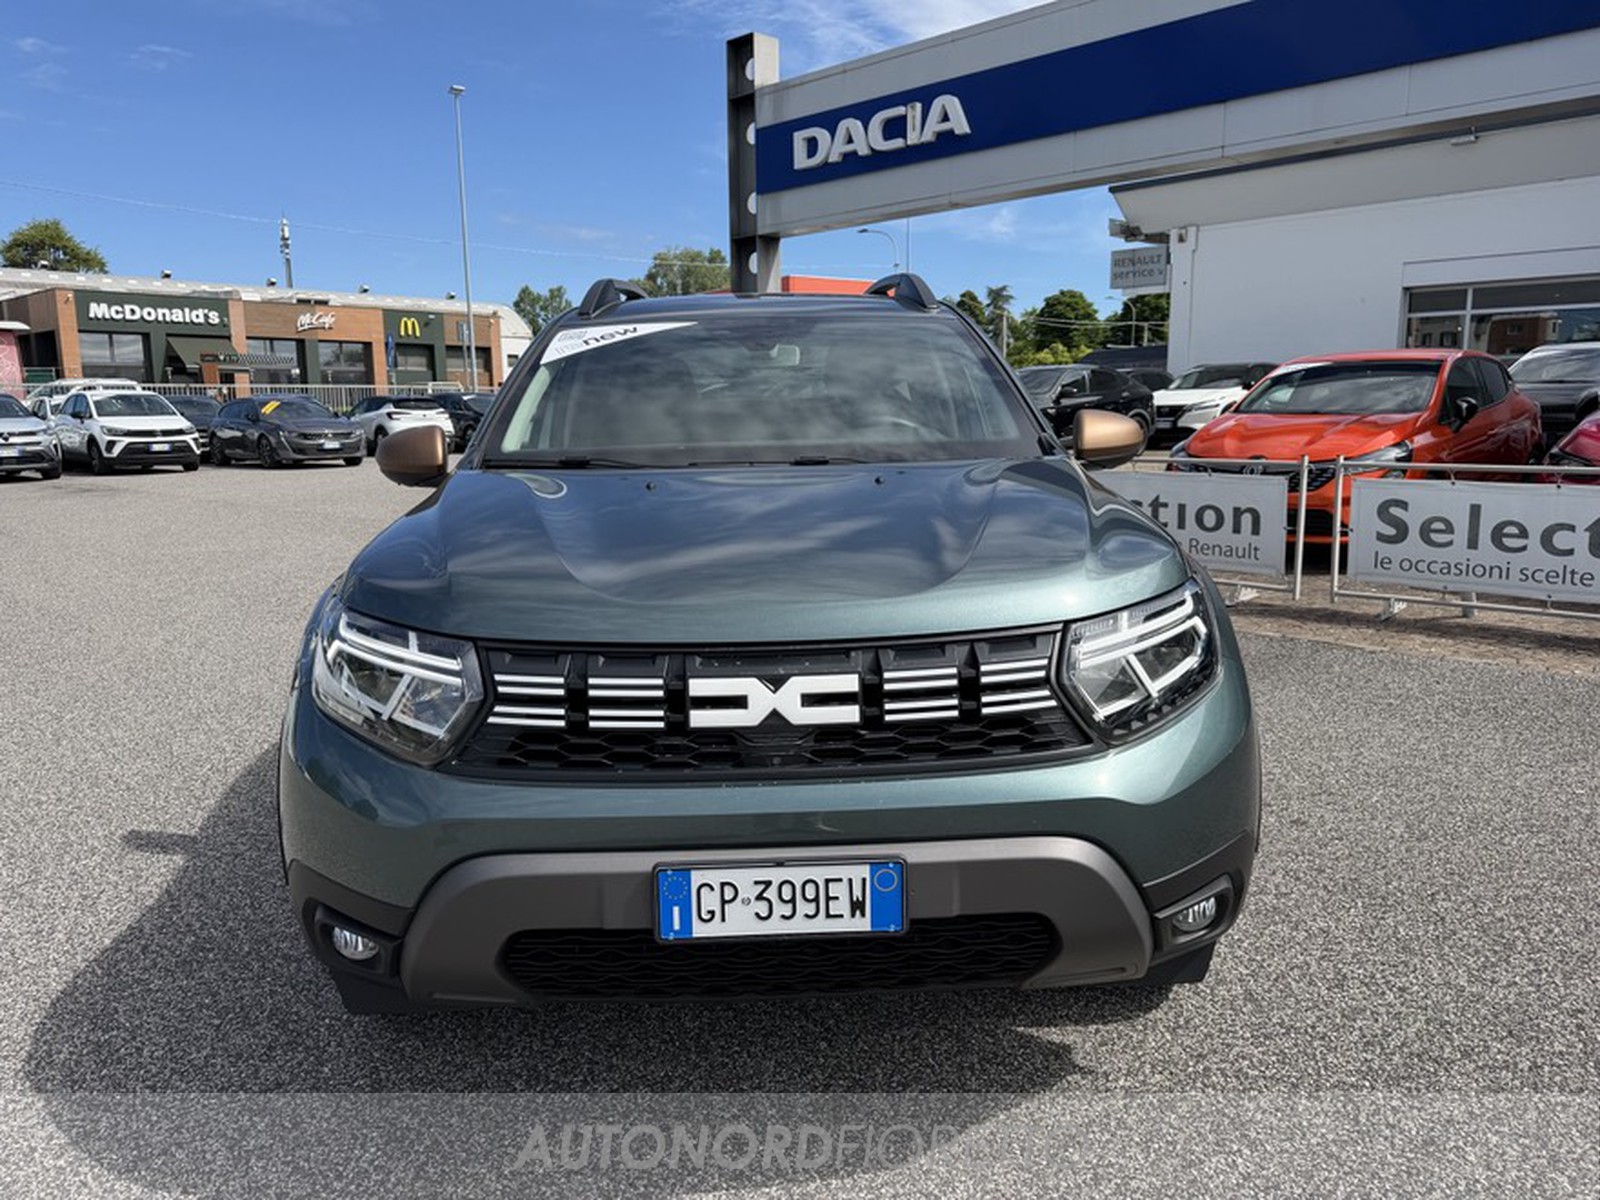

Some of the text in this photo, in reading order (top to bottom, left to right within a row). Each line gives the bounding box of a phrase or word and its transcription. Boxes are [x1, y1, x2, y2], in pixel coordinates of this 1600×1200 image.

[793, 94, 971, 170] DACIA
[1113, 254, 1162, 268] RENAULT
[1113, 268, 1156, 280] service
[88, 302, 220, 324] McDonald's
[1130, 494, 1262, 536] tion
[1188, 537, 1260, 562] Renault
[1373, 551, 1596, 588] le occasioni scelte
